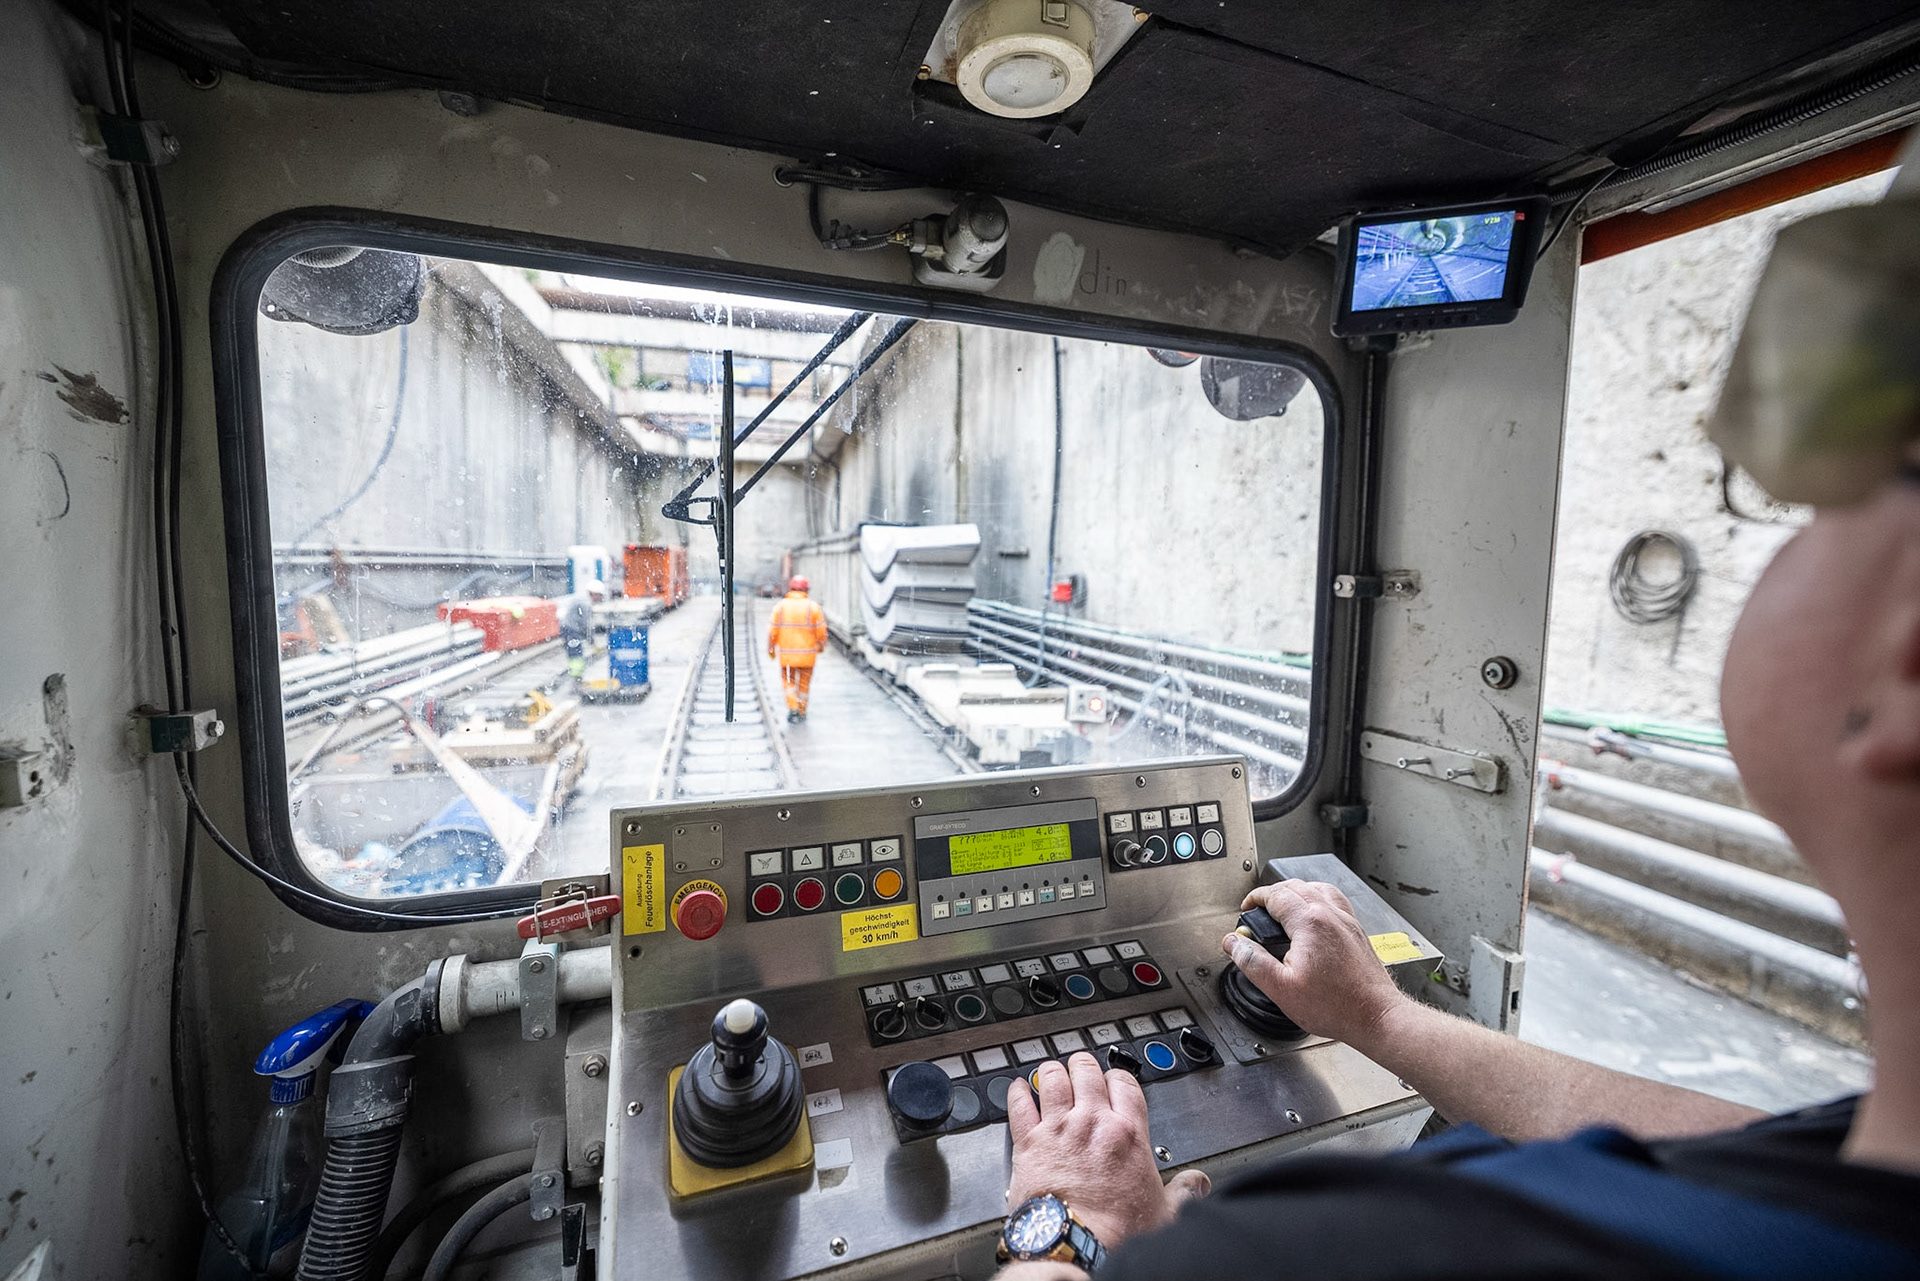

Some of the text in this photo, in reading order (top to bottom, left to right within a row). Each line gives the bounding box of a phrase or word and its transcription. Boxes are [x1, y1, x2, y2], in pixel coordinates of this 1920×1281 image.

[1036, 826, 1053, 836] 4.0
[1038, 852, 1056, 863] 4.0
[636, 873, 644, 907] Auslösung
[645, 850, 654, 928] Feuerlöschanlage
[674, 882, 724, 905] EMERGENCY
[864, 912, 894, 922] Höchst-
[849, 918, 910, 936] geschwindigkeit
[862, 930, 899, 944] 30 km/h
